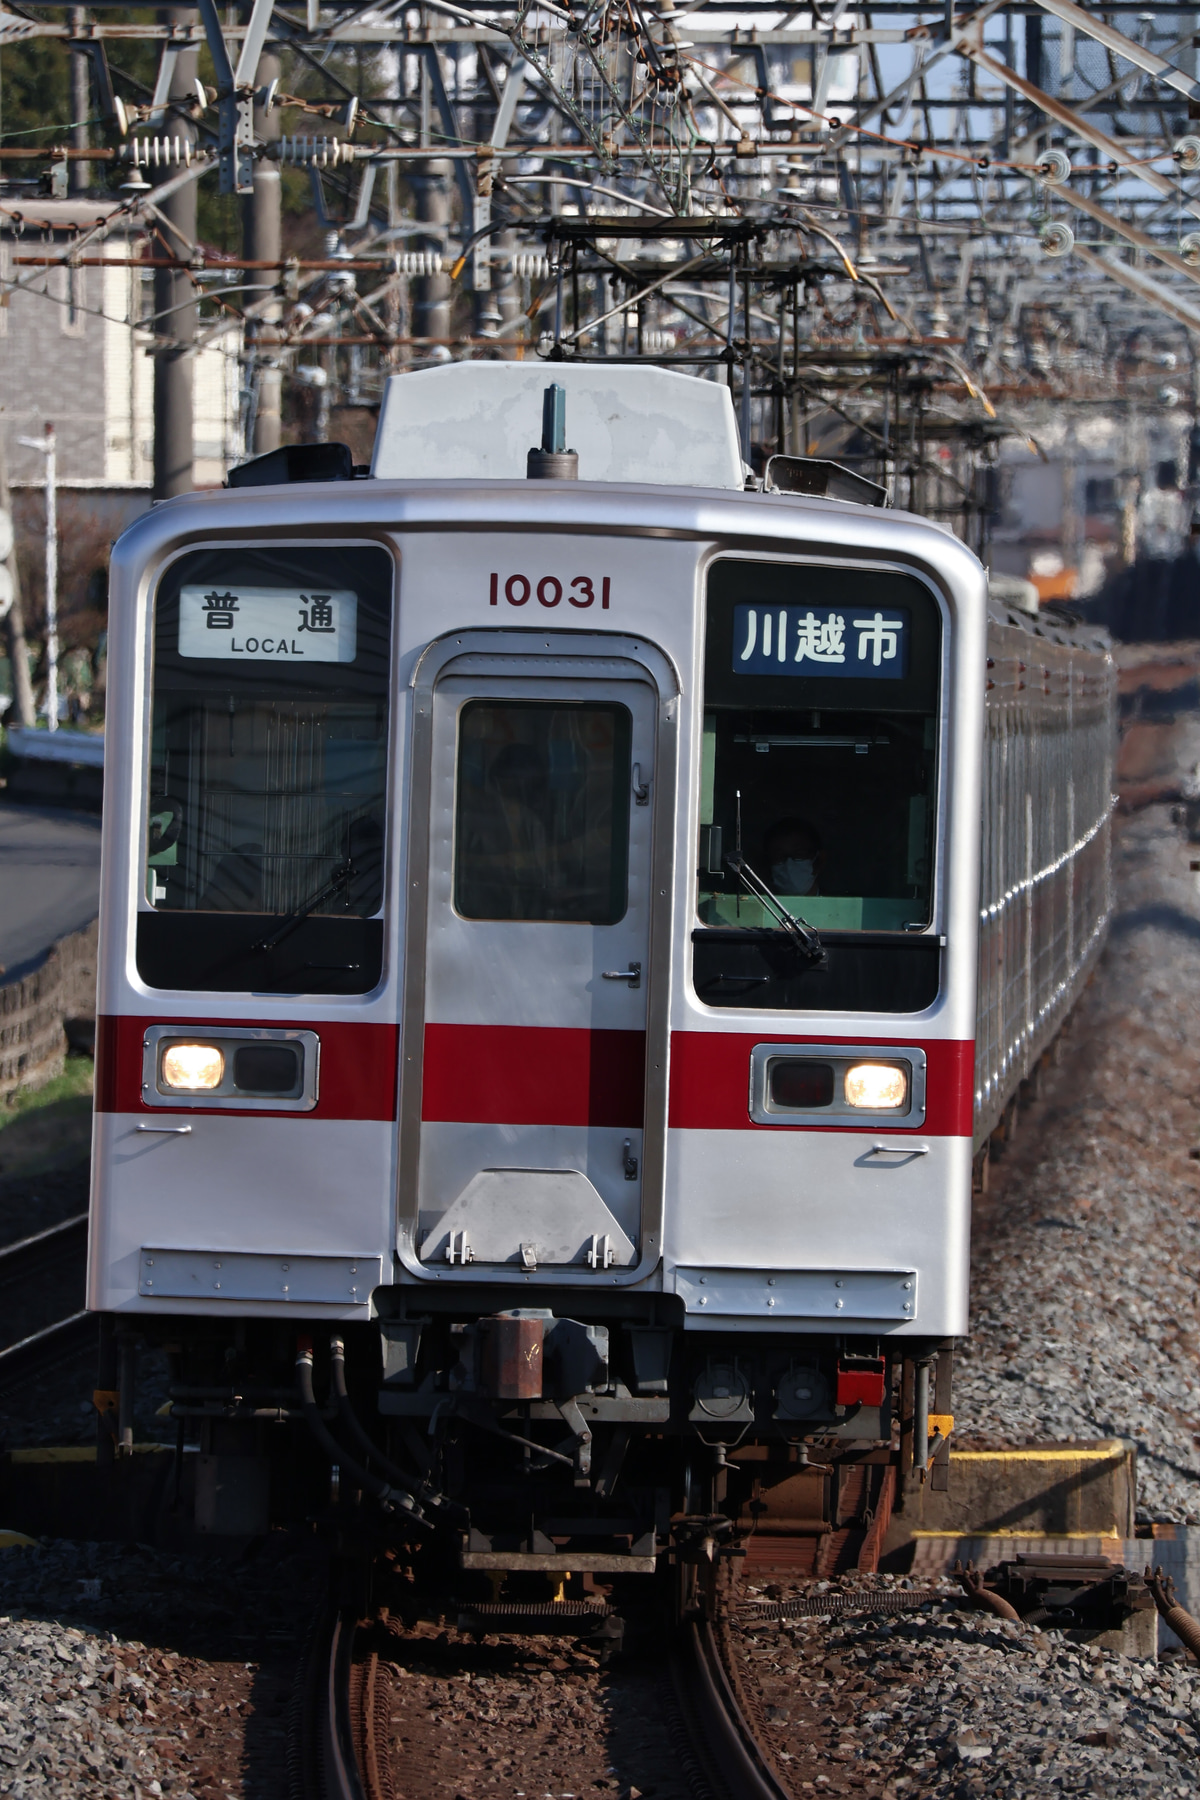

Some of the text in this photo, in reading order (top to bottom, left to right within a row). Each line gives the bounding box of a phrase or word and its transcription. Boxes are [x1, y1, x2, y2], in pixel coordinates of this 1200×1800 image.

[490, 573, 611, 609] 10031
[231, 637, 304, 655] LOCAL
[740, 609, 904, 667] 川越市
